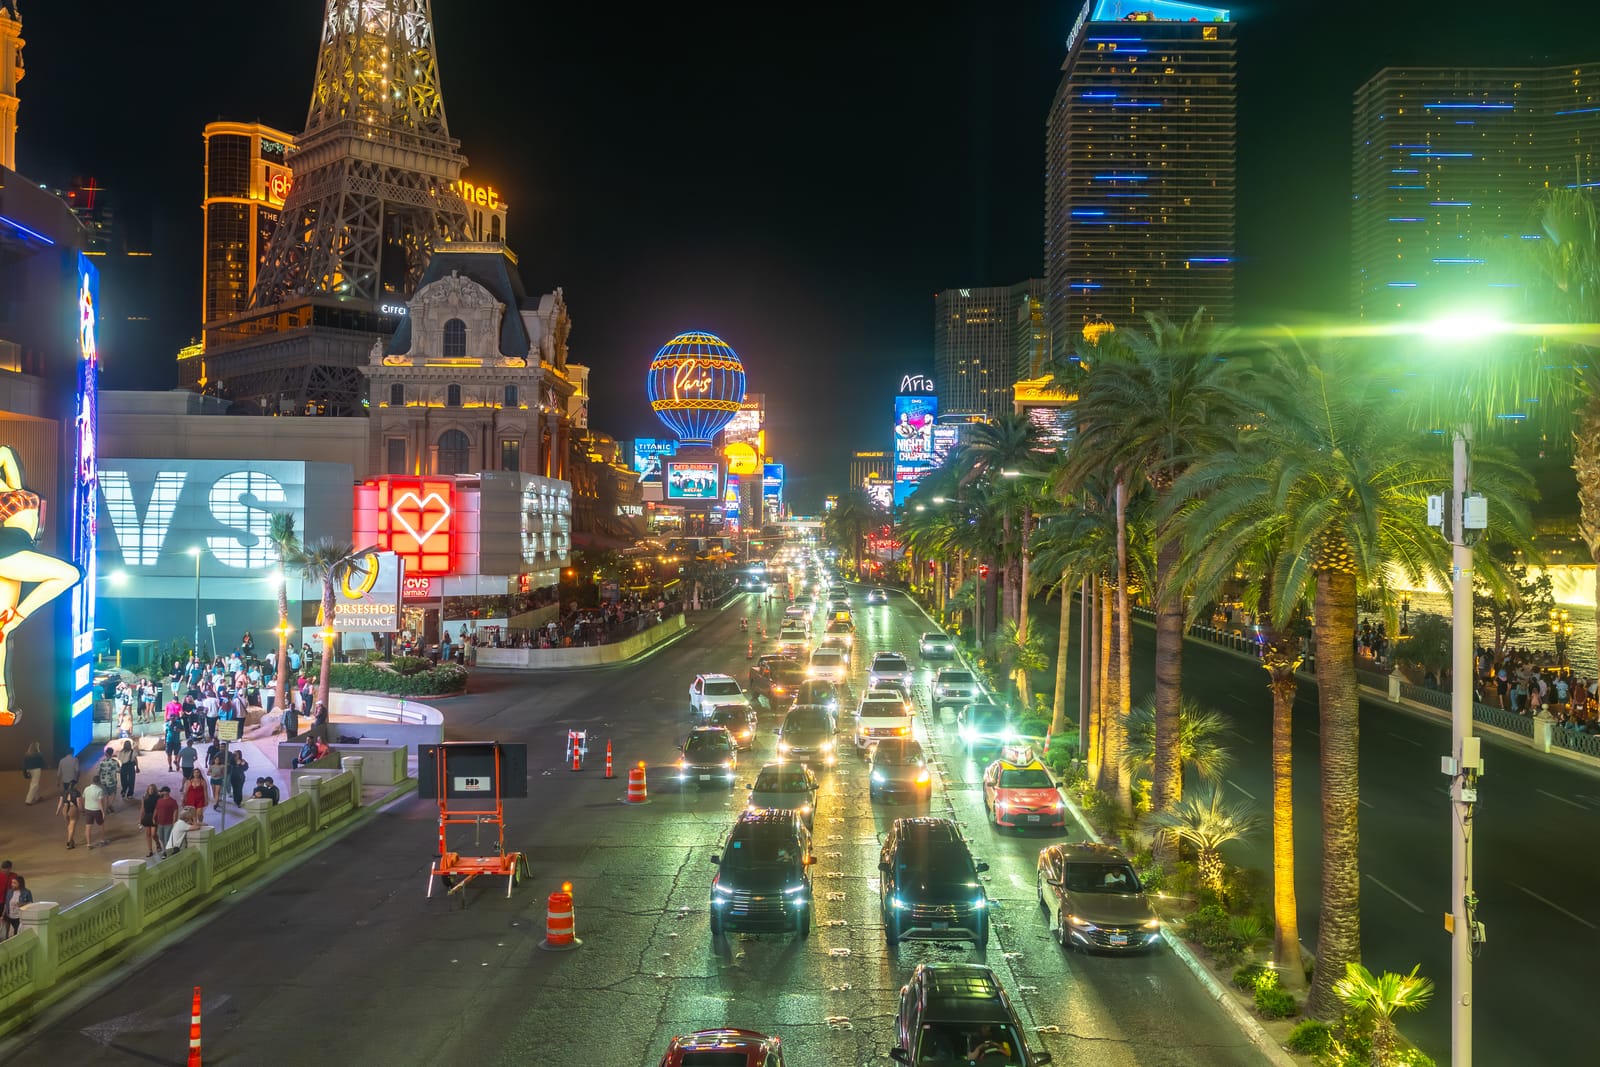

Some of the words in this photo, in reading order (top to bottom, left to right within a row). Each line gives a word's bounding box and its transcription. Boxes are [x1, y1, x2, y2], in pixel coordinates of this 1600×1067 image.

[458, 180, 498, 210] net
[673, 359, 712, 403] Paris
[900, 375, 934, 392] Aria
[97, 470, 288, 569] VS
[406, 578, 429, 588] CVS
[403, 590, 428, 598] armacy
[334, 603, 396, 615] ORSESHOE
[343, 617, 392, 627] ENTRANCE
